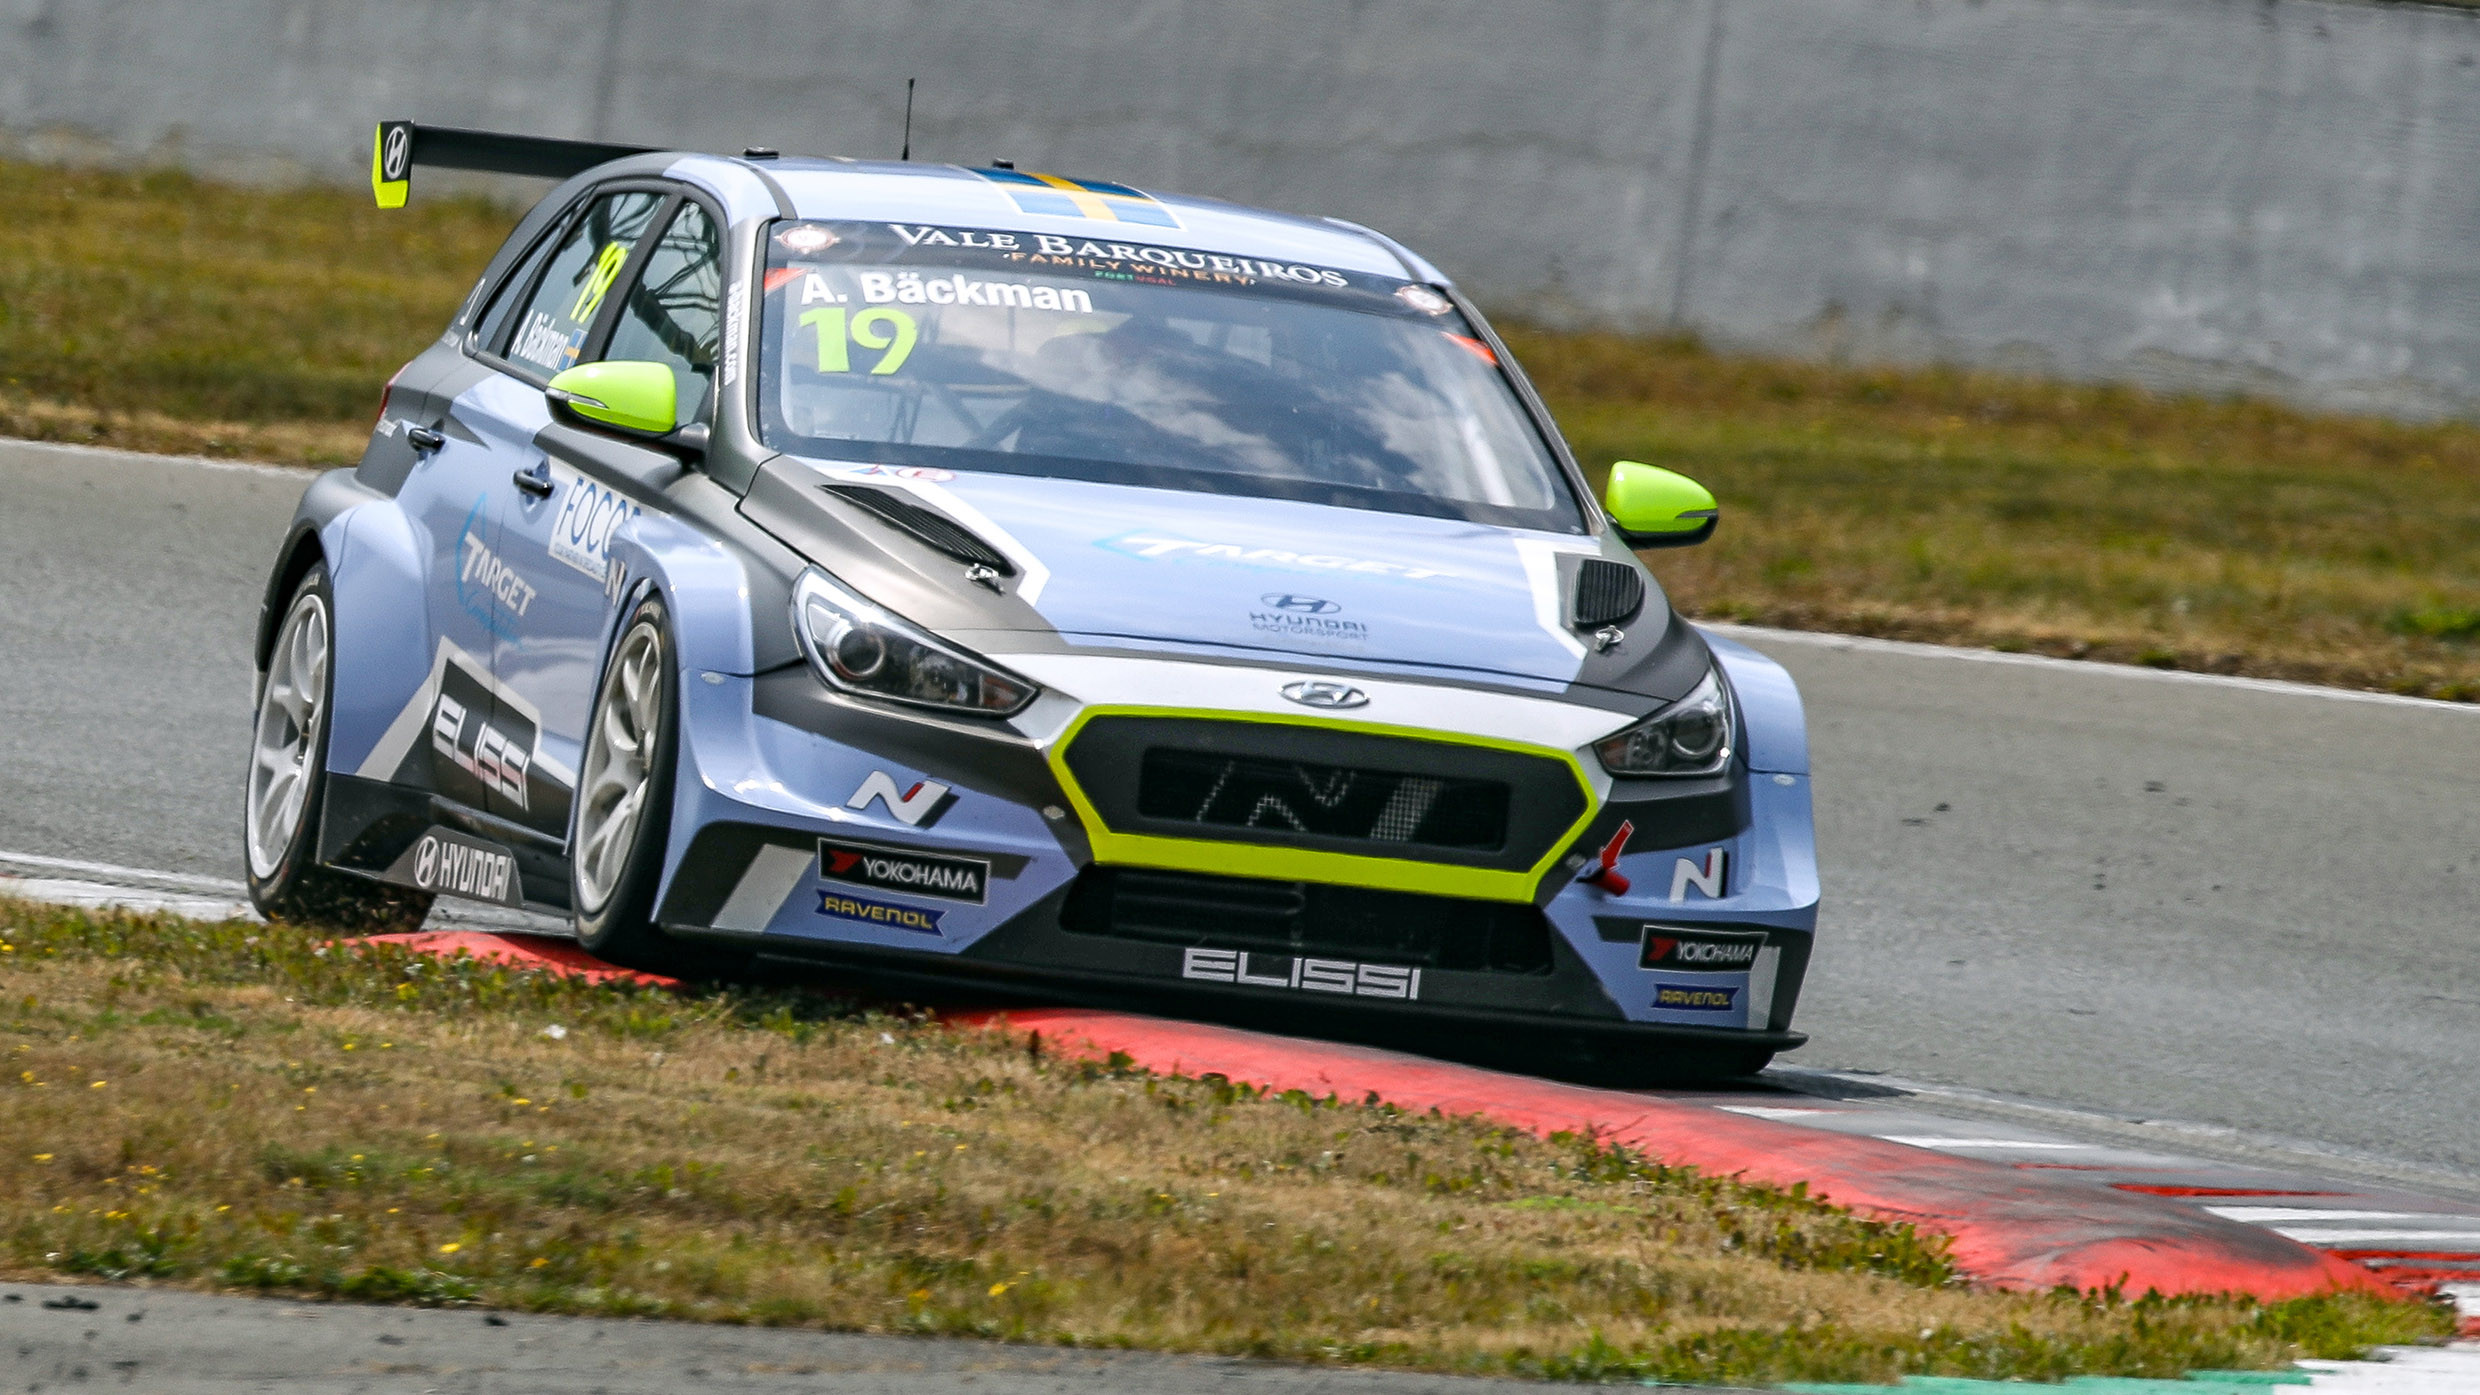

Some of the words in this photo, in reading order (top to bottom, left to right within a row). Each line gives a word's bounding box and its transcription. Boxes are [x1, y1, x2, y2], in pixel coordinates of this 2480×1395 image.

[887, 224, 1020, 249] VALE
[1033, 235, 1349, 288] BARQUEIROS
[569, 241, 627, 323] 19
[801, 274, 848, 304] A.
[860, 271, 1092, 315] Bäckman
[799, 307, 918, 375] 19
[461, 531, 537, 617] TARGET
[1121, 537, 1462, 580] TARGET
[1249, 612, 1367, 632] HYUNDAI
[1252, 623, 1368, 640] MOTORSPORT
[433, 693, 530, 812] ELISSI
[439, 841, 512, 901] HYUNDAI
[863, 856, 978, 893] YOKOHAMA
[825, 896, 932, 930] RAVENOL
[1183, 947, 1421, 1000] ELISSI
[1676, 940, 1754, 963] YOKOHAMA
[1659, 988, 1730, 1006] RAVENOL
